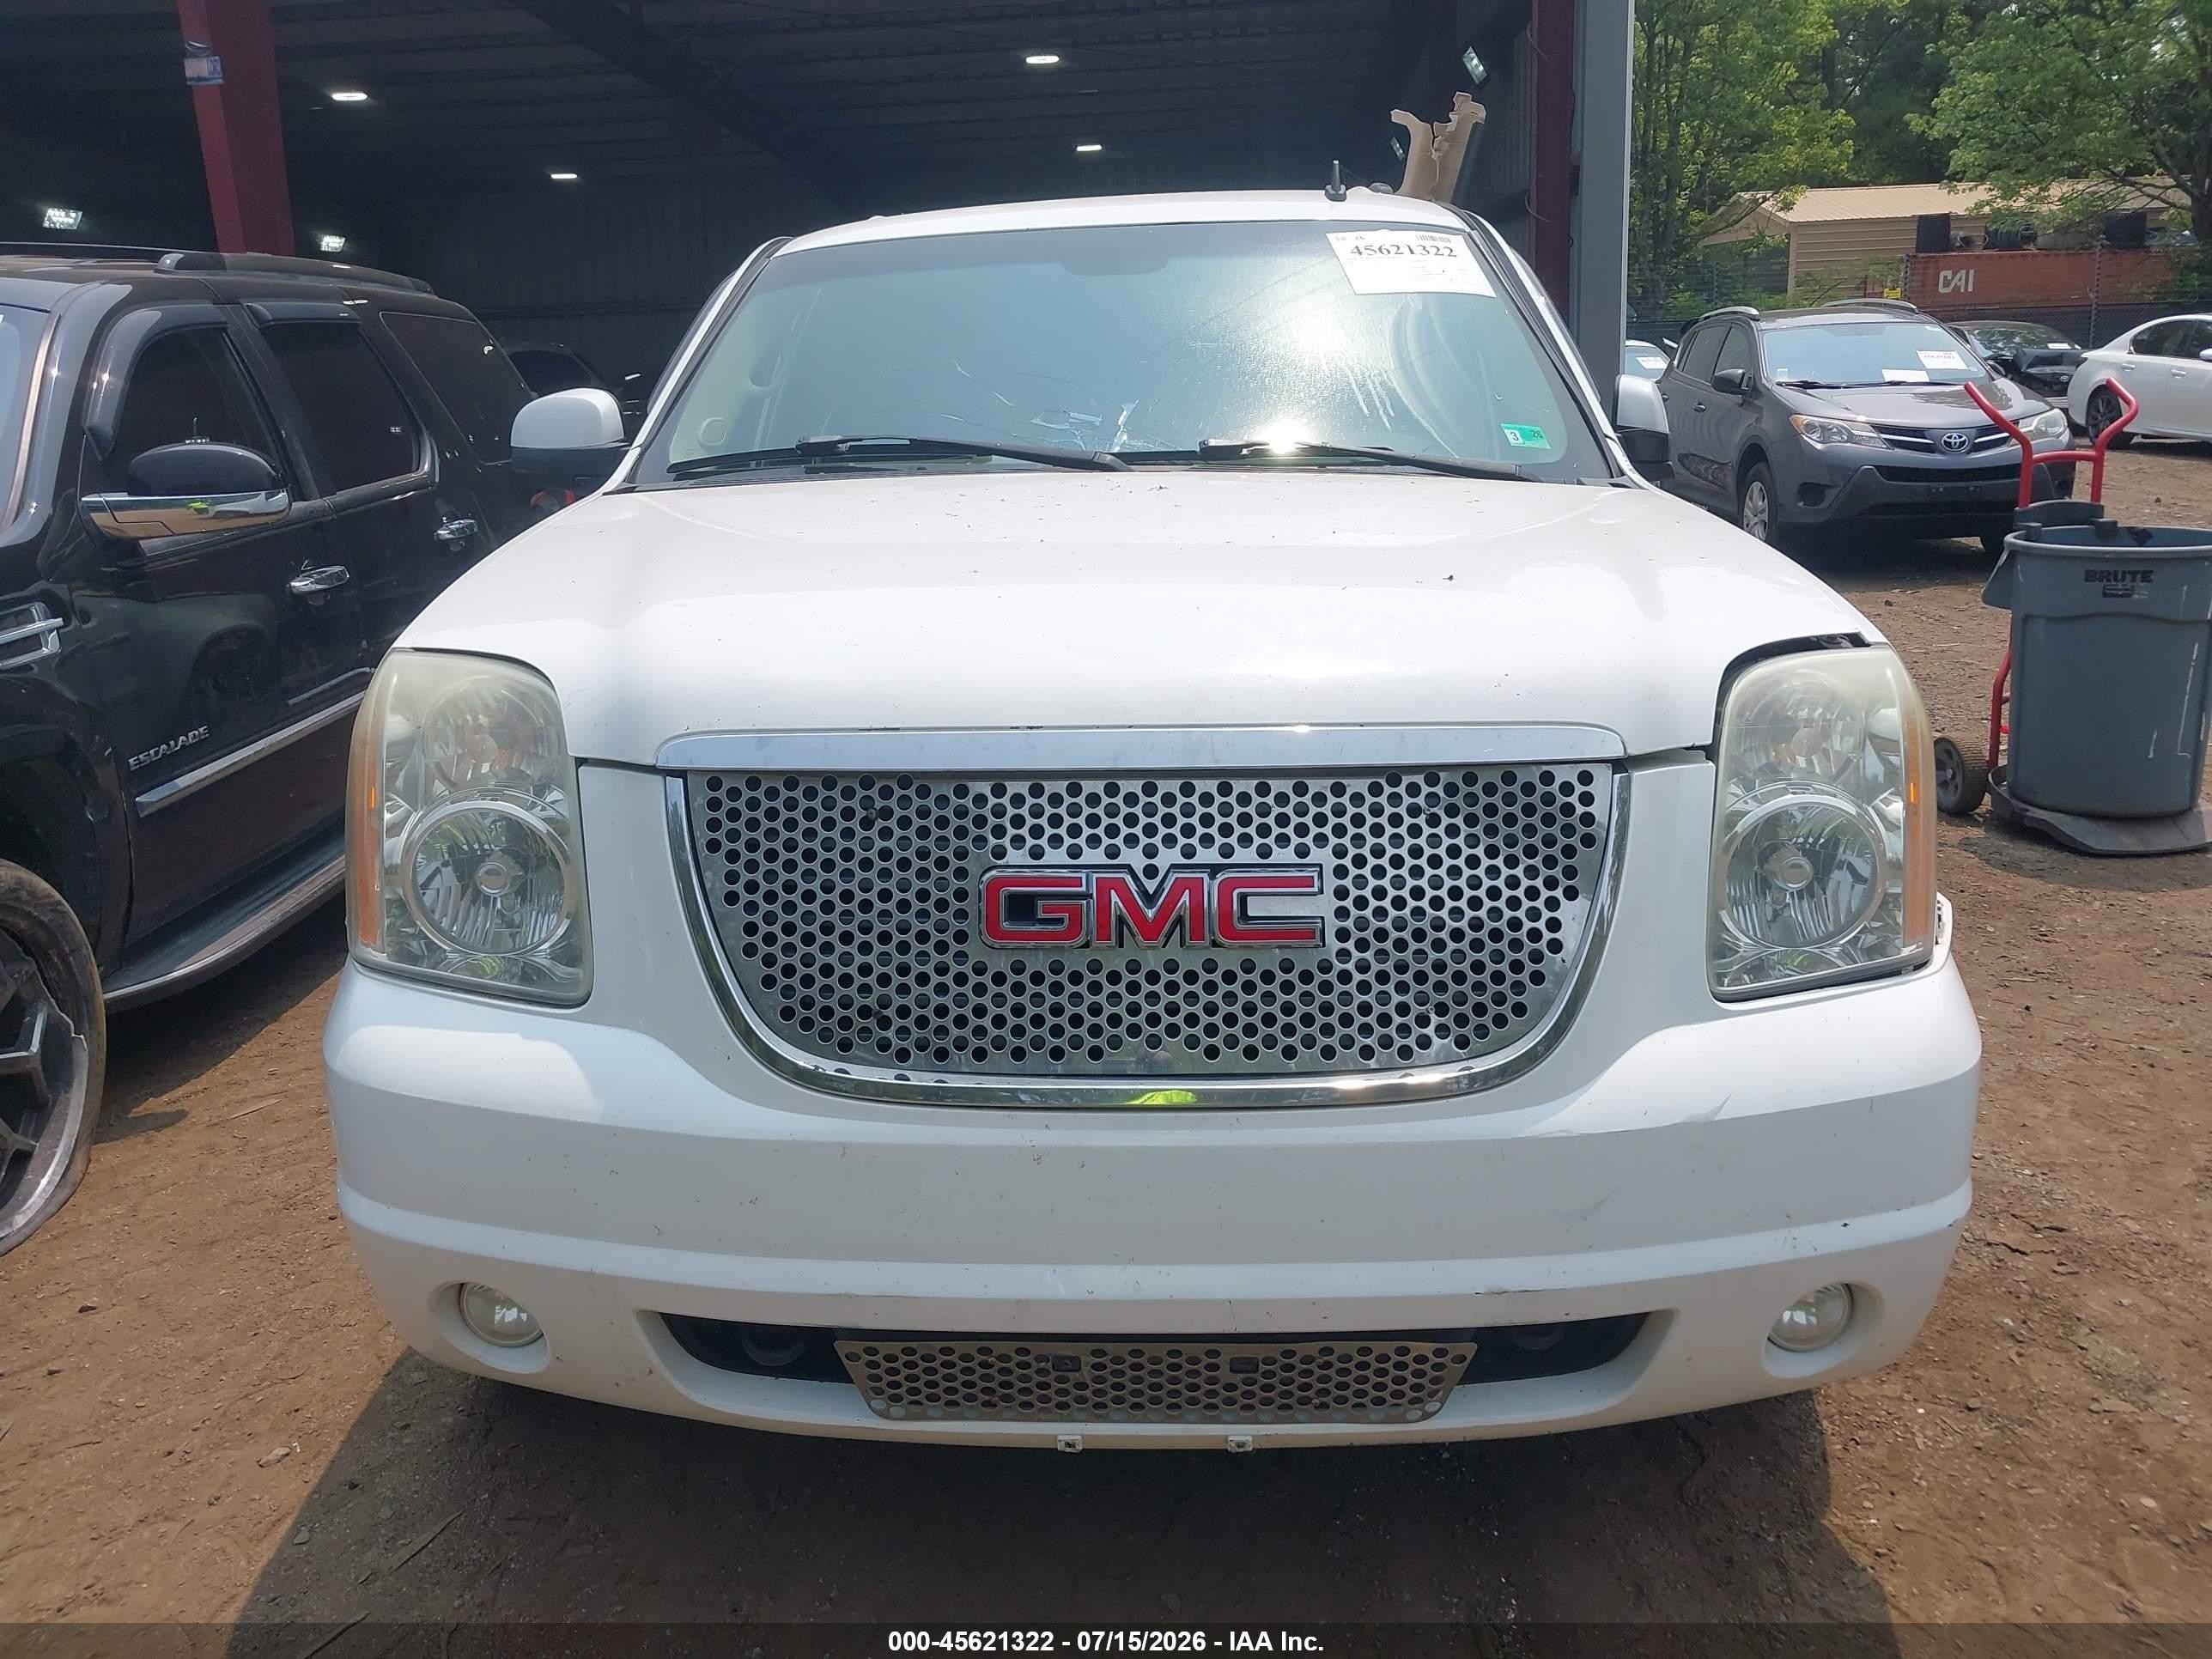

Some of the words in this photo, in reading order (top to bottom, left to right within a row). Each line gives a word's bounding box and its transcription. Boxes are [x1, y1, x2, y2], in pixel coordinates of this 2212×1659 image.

[1351, 244, 1456, 257] 45621322
[1938, 270, 1975, 294] CAI
[1510, 431, 1519, 441] 3
[2084, 569, 2154, 582] BRUTE
[129, 726, 209, 770] ESCALADE
[981, 866, 1323, 947] GMC
